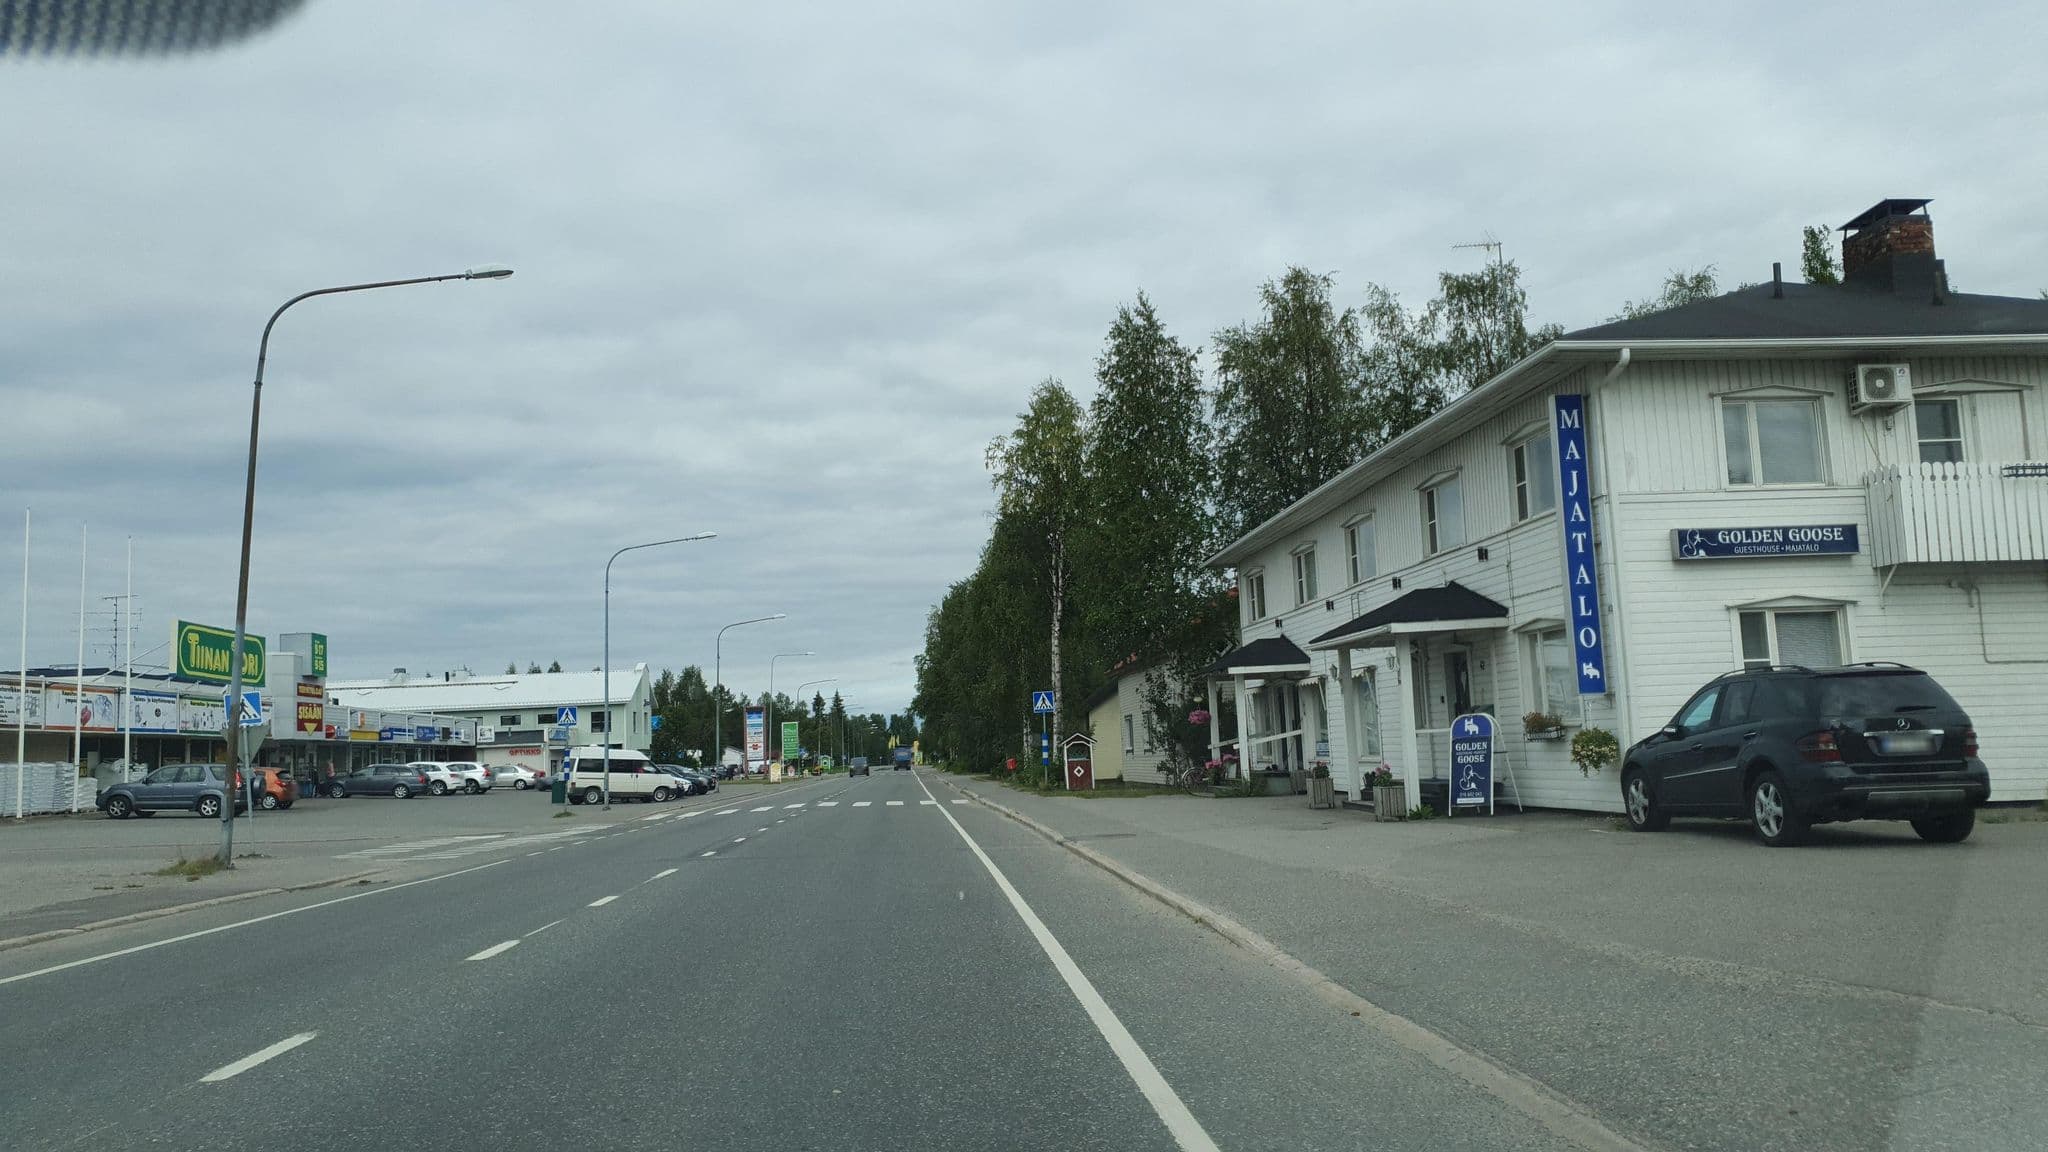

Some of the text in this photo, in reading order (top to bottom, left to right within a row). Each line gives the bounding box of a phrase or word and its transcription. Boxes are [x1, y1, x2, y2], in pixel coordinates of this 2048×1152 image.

[1559, 408, 1598, 649] MAJATALO
[1718, 528, 1843, 544] GOLDEN GOOSE
[1734, 543, 1820, 554] GUESTHOUSE MAJATALO
[187, 632, 230, 673] TIINAN
[1455, 741, 1488, 751] GOLDEN
[1457, 754, 1485, 764] GOOSE
